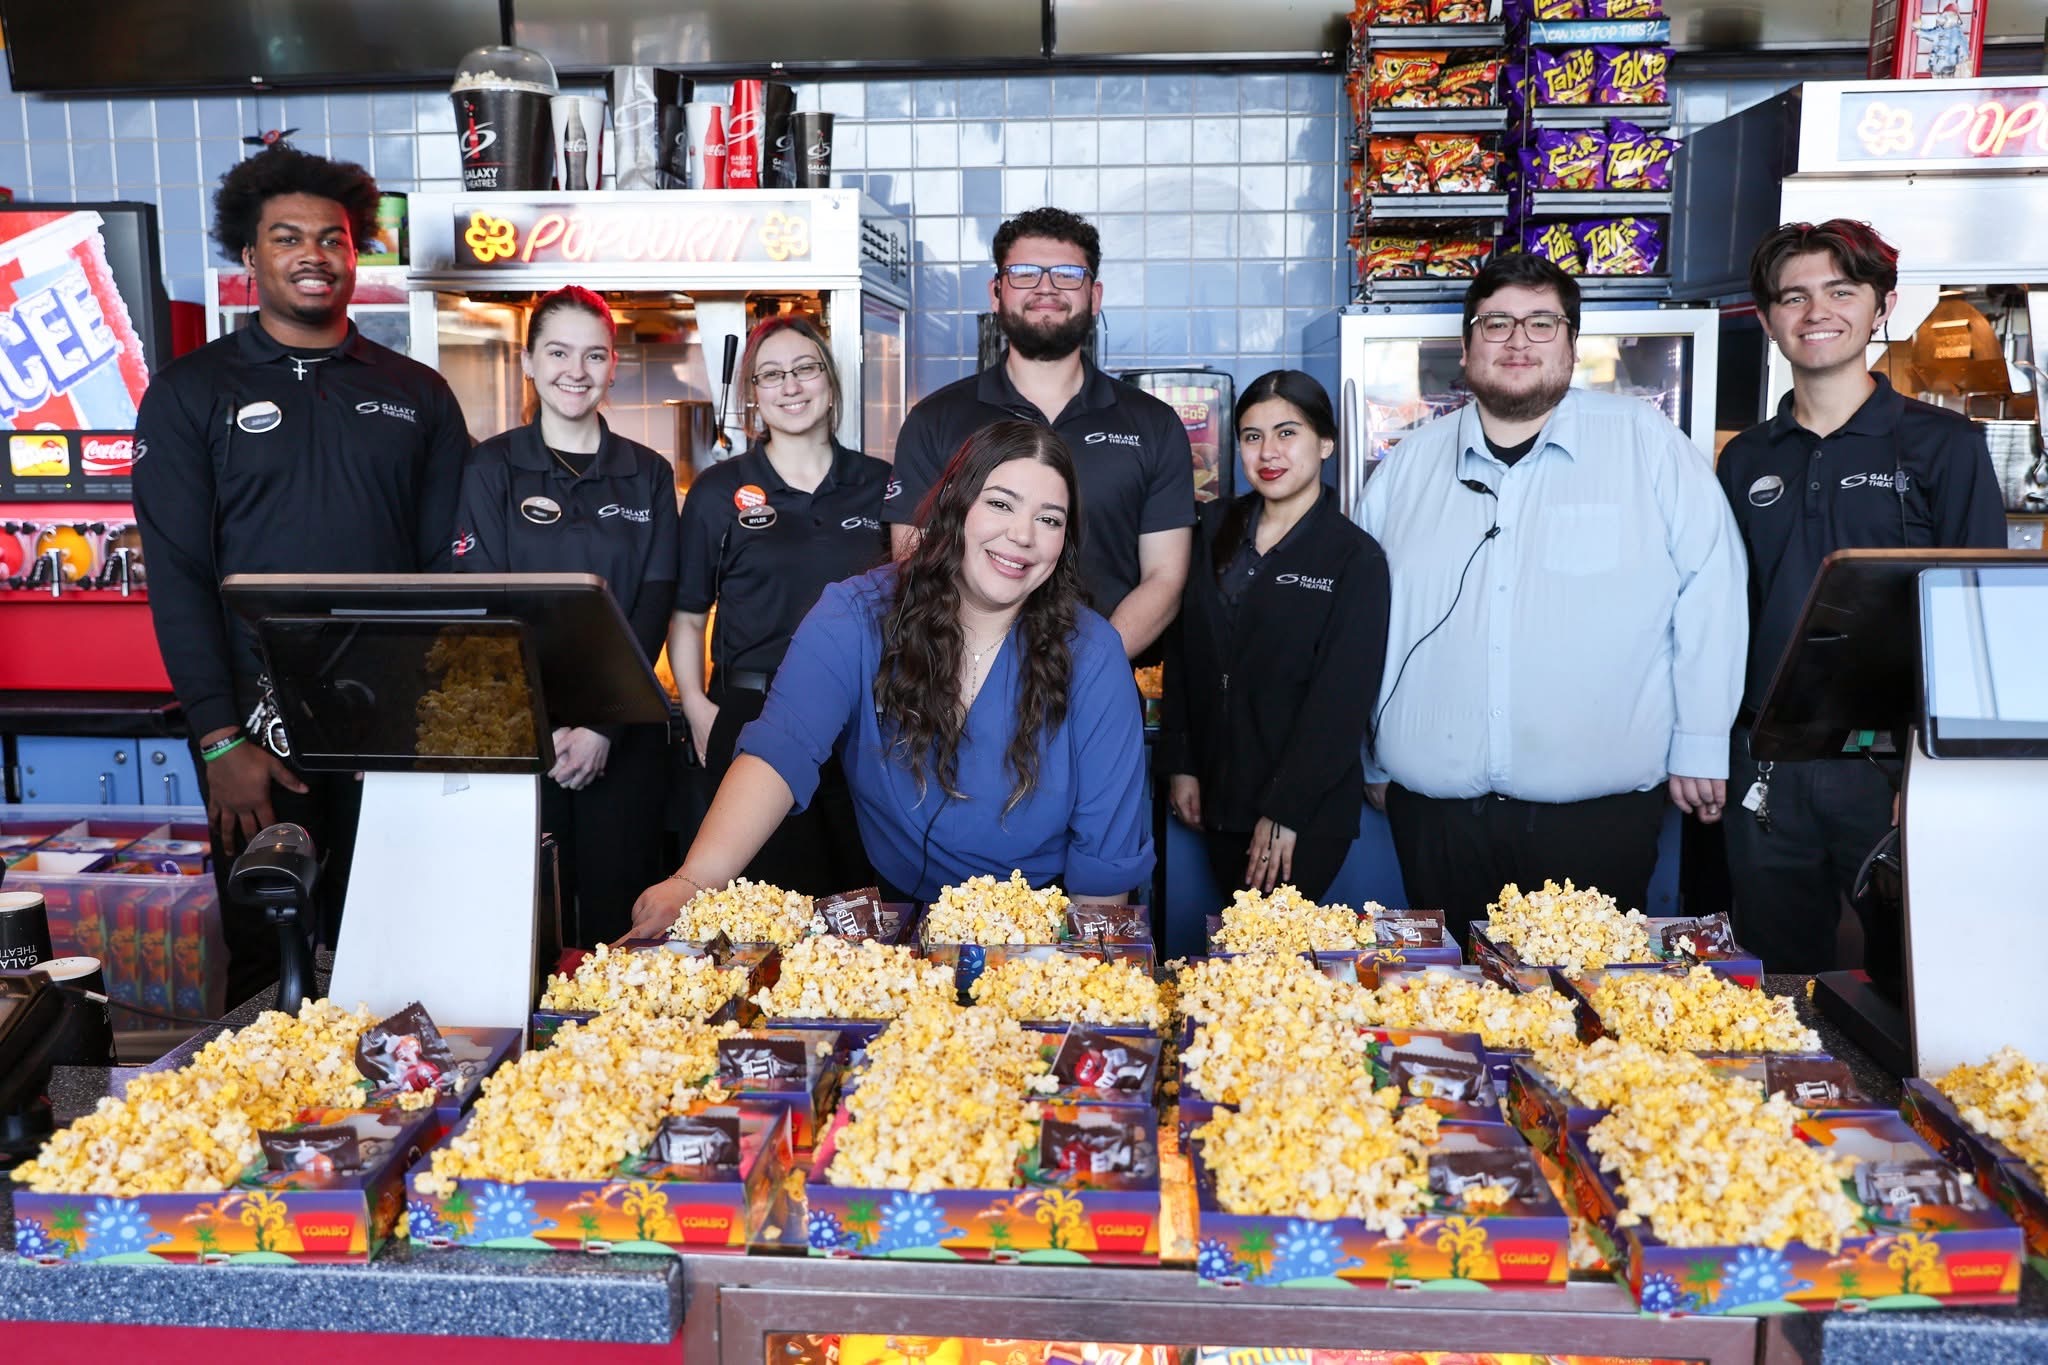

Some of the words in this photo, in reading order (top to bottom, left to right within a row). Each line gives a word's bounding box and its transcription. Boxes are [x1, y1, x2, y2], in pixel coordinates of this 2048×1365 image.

[1548, 30, 1568, 41] CAN
[1570, 29, 1590, 40] YOU
[1592, 25, 1617, 41] TOP
[1543, 49, 1595, 99] Takis
[1611, 50, 1666, 89] Takis
[522, 211, 754, 264] POPCORN
[382, 403, 416, 416] GALAXY
[1108, 433, 1140, 443] GALAXY
[1299, 581, 1333, 593] THEATRES
[1301, 575, 1334, 586] GALAXY
[682, 1216, 728, 1229] COMBO
[303, 1225, 349, 1237] COMBO
[1096, 1224, 1144, 1237] COMBO
[1500, 1253, 1549, 1265] COMBO
[1951, 1264, 2003, 1279] COMBO
